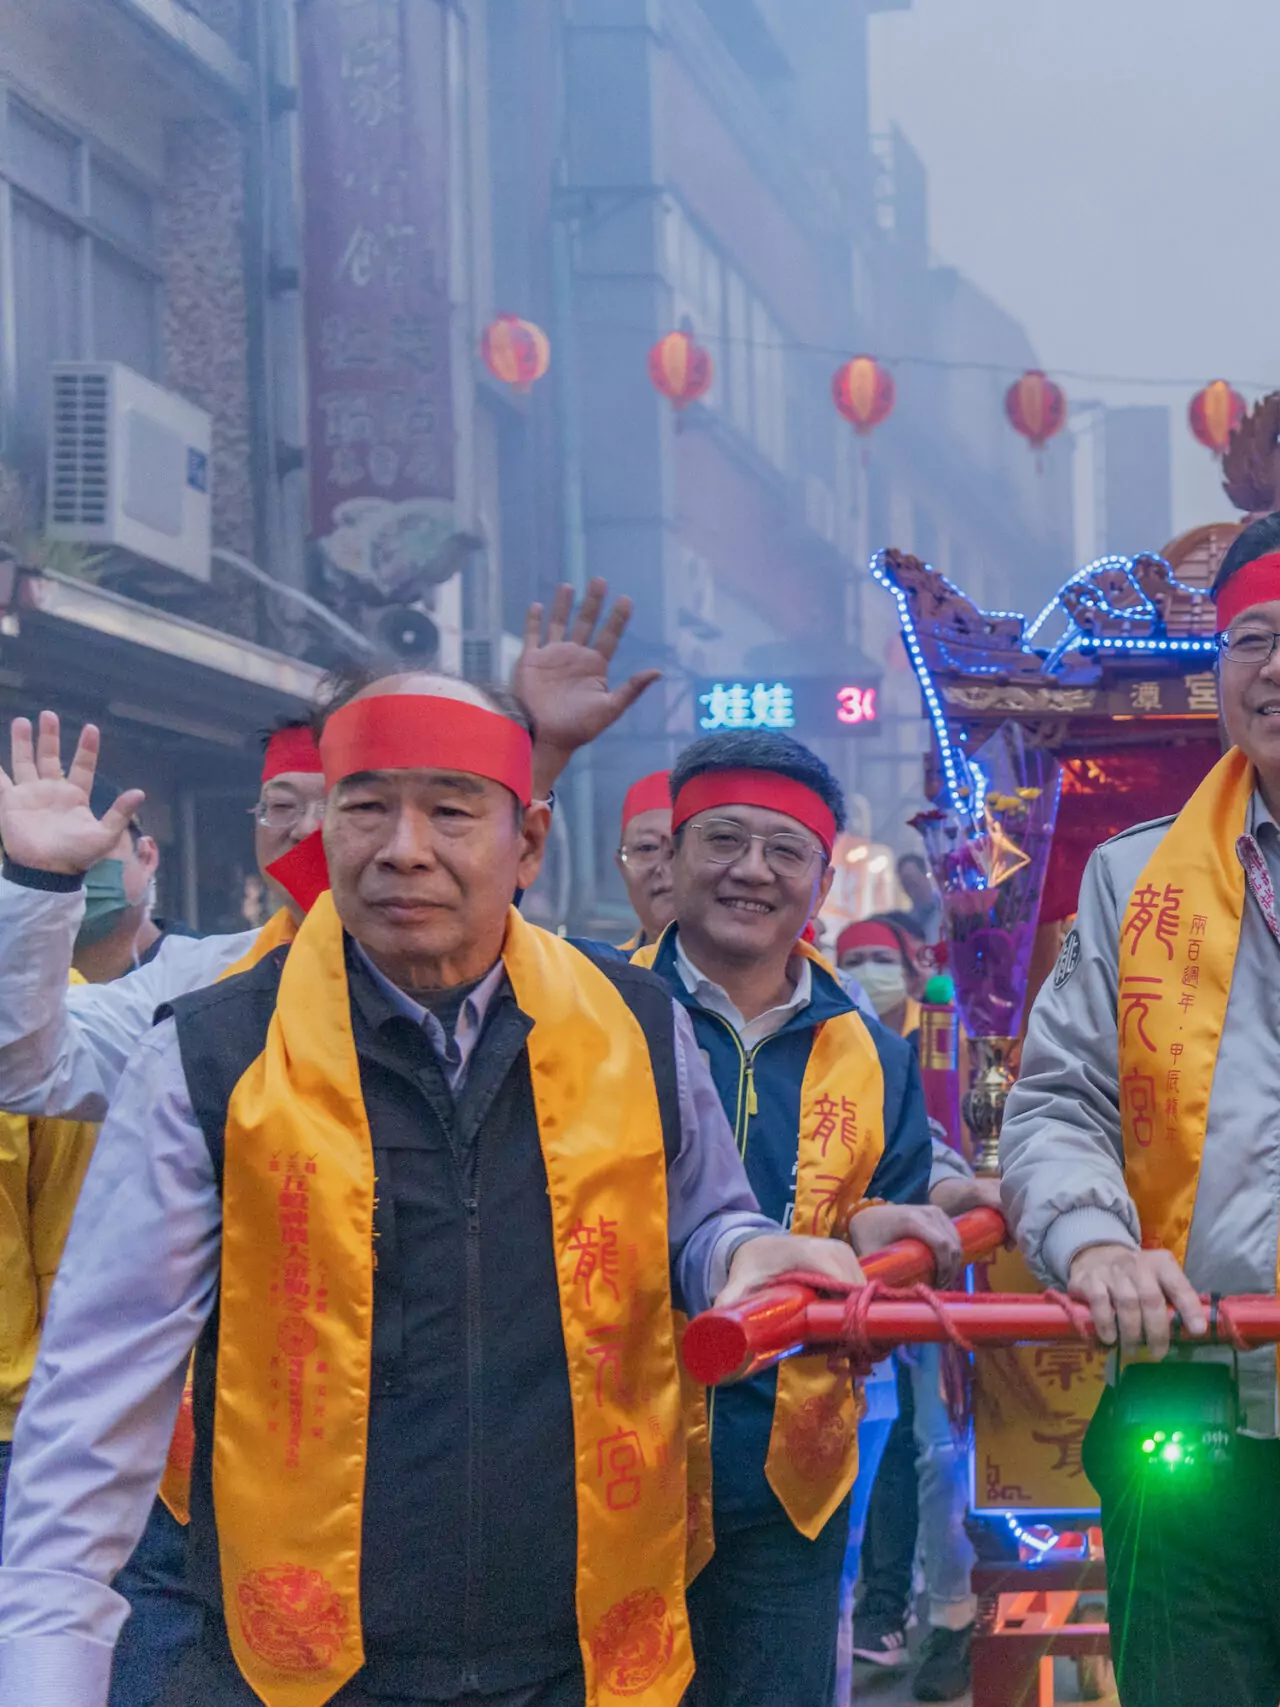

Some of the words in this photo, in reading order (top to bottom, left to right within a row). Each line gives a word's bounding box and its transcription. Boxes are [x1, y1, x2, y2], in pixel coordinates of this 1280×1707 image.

[699, 682, 796, 730] 娃娃
[1121, 883, 1184, 1147] 龍元宮
[568, 1214, 643, 1511] 龍元宮
